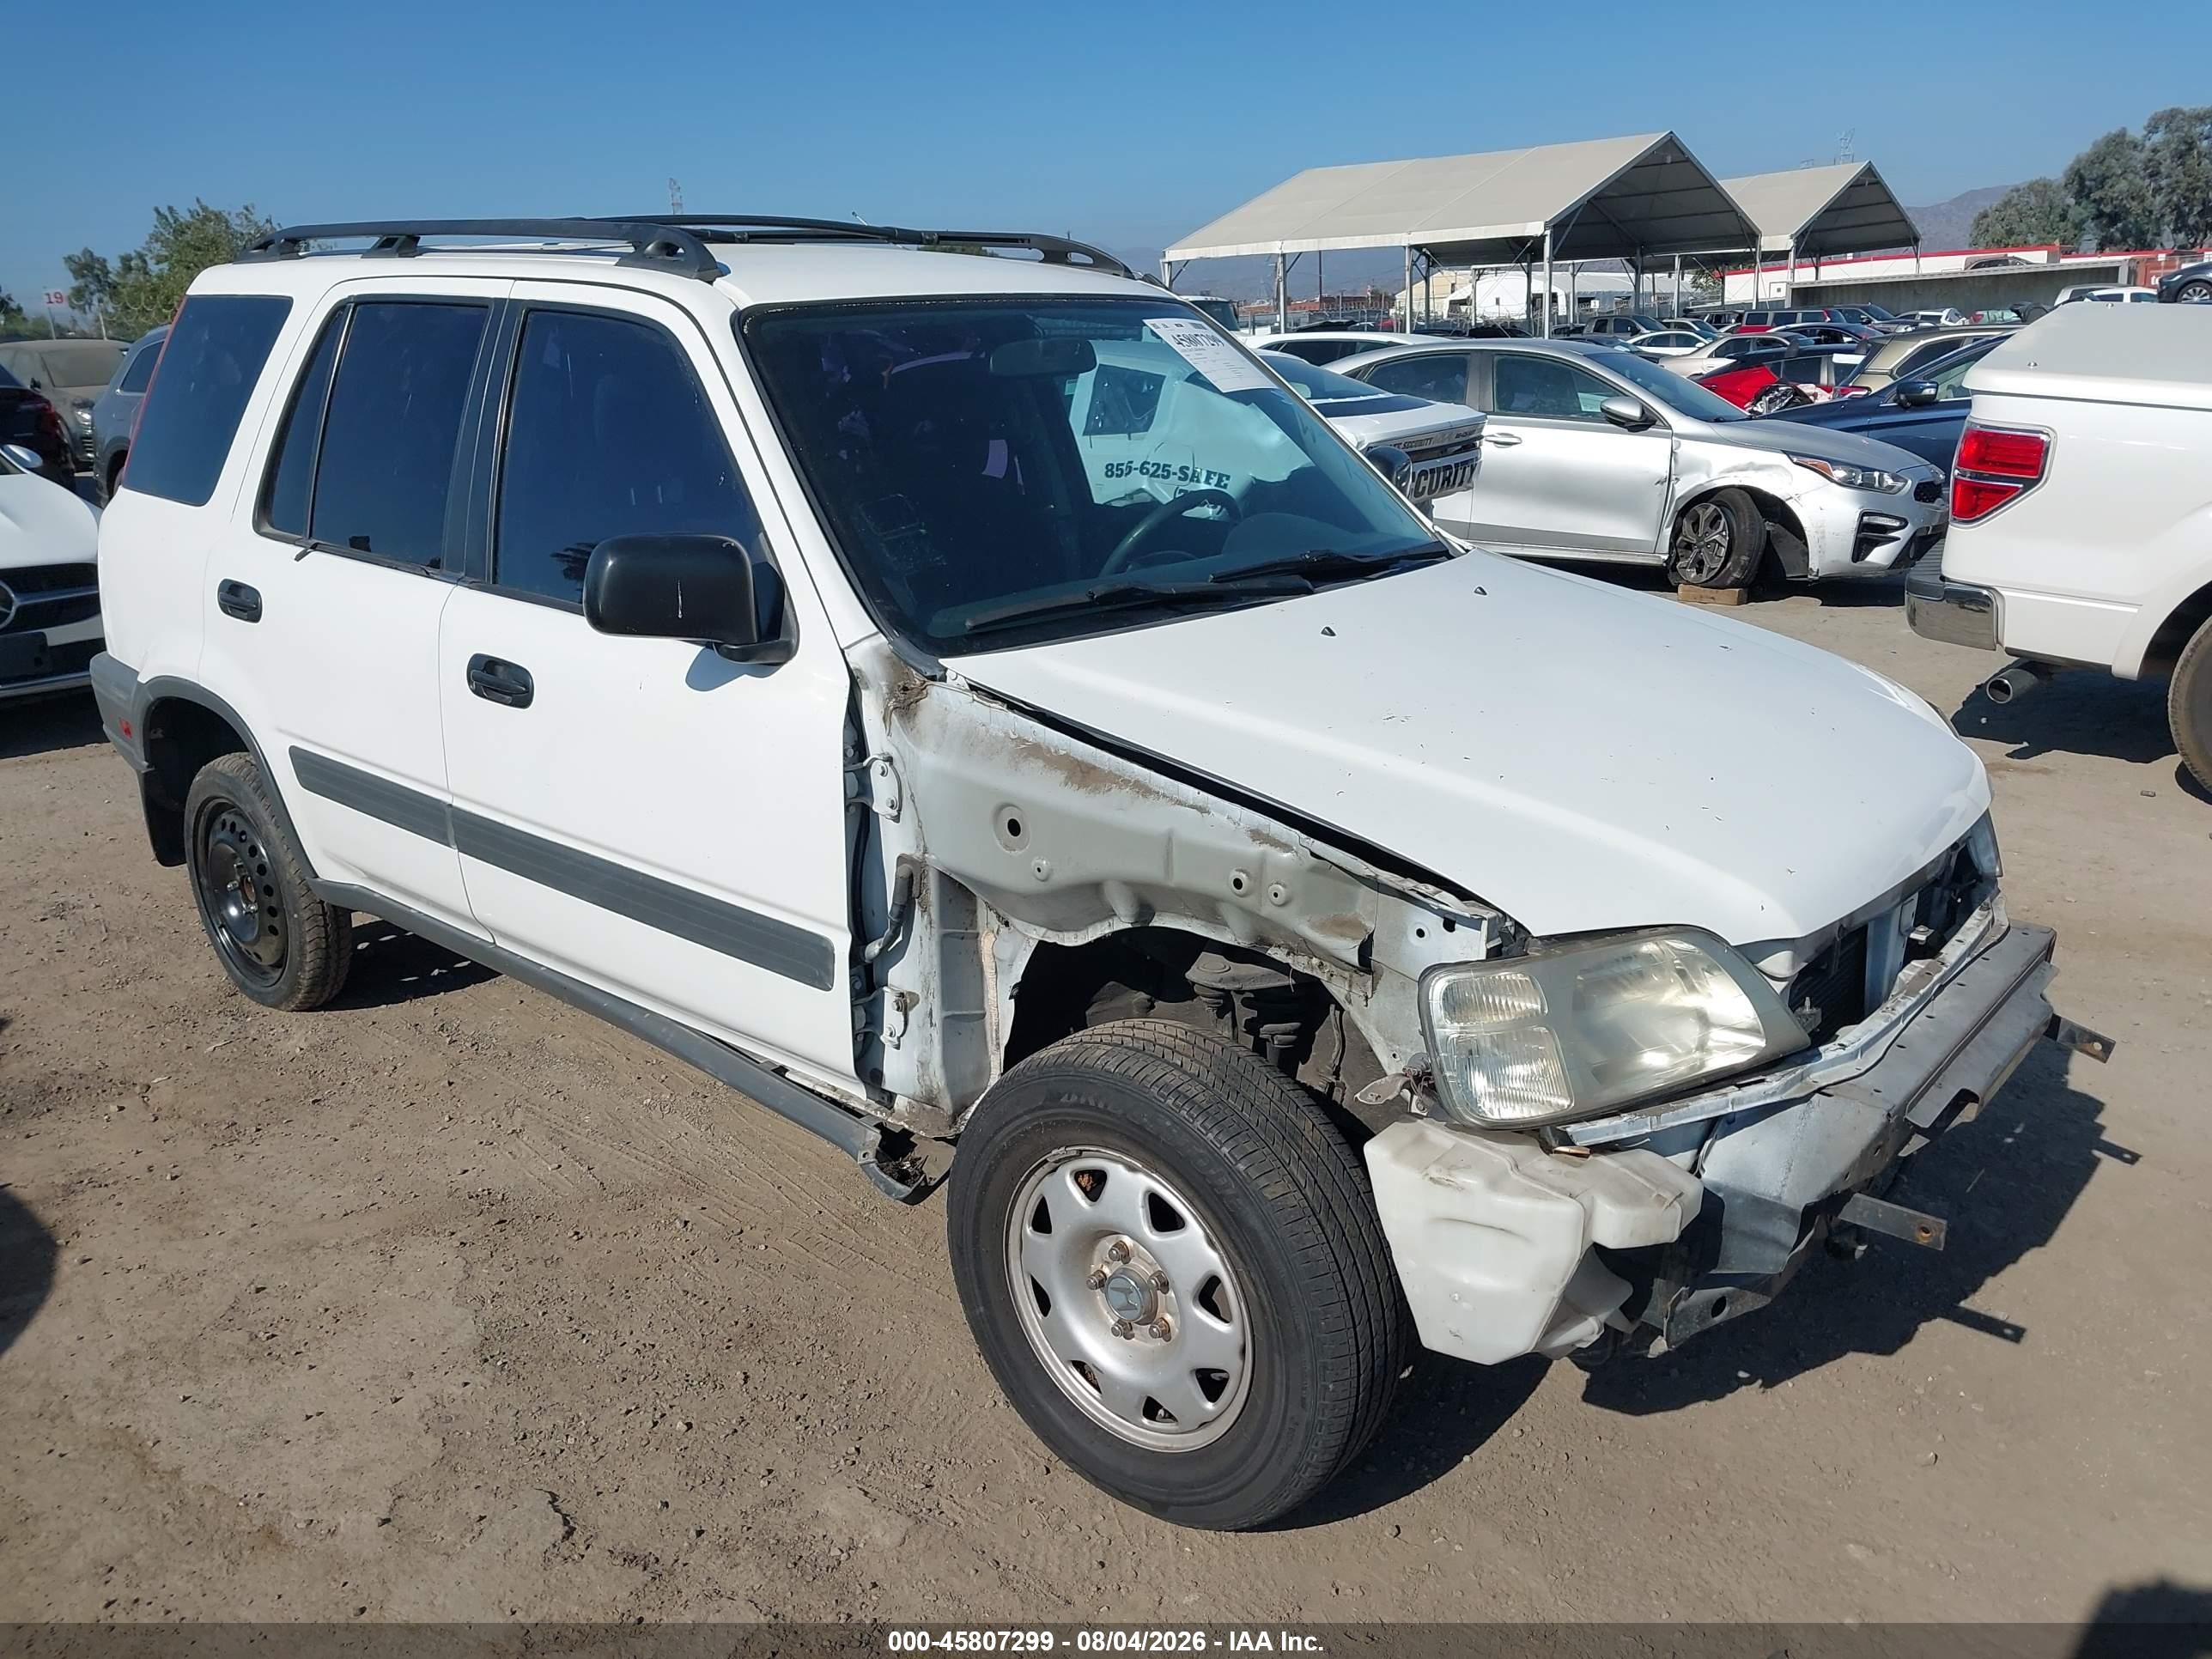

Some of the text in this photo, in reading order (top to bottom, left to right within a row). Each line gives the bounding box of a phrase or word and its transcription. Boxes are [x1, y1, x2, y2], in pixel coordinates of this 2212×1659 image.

[45, 291, 64, 304] 19
[1170, 332, 1224, 348] 45807299
[1104, 460, 1231, 489] 855-625-SAFE
